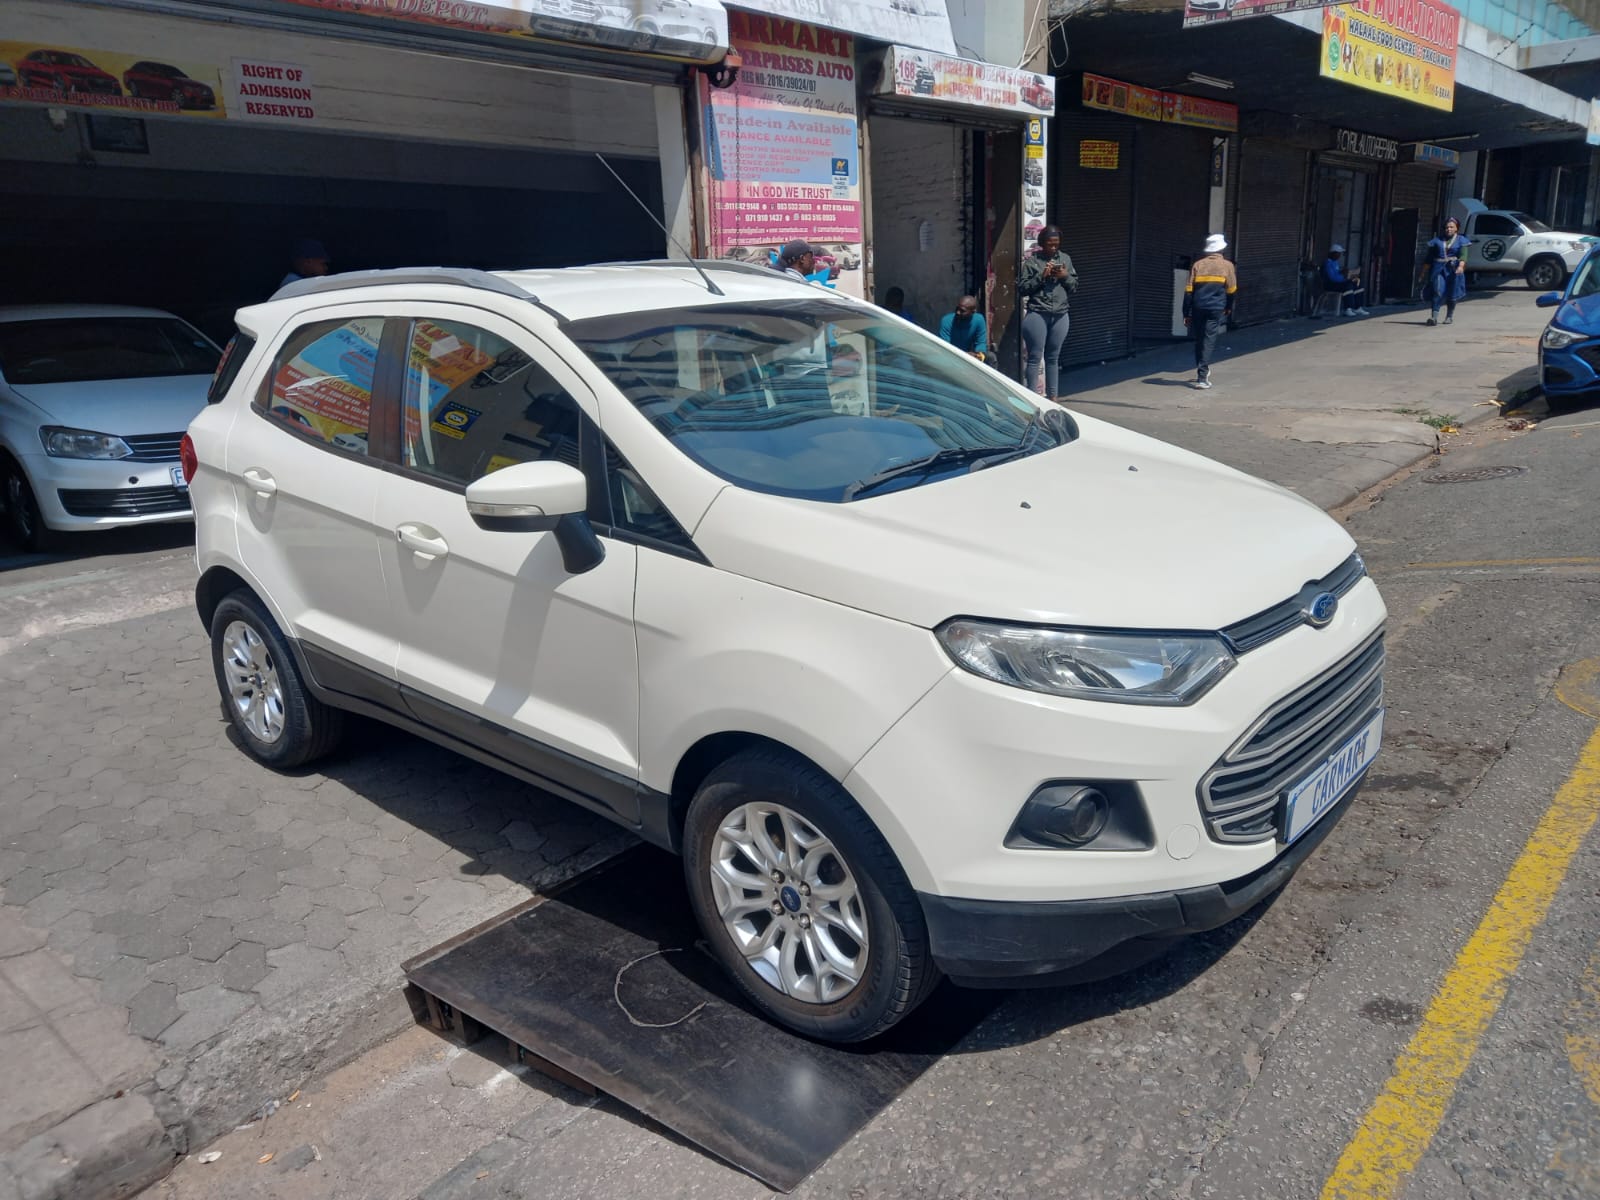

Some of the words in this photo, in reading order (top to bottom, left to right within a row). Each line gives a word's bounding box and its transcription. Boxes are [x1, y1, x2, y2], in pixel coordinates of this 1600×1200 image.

[730, 10, 853, 58] ARMART
[1349, 17, 1377, 44] HALAAL
[1377, 30, 1393, 51] FOOD
[242, 64, 283, 80] RIGHT
[287, 69, 303, 82] OF
[741, 50, 814, 76] ERPRISES
[816, 61, 854, 81] AUTO
[899, 60, 916, 80] 168
[240, 83, 312, 101] ADMISSION
[247, 103, 314, 119] RESERVED
[716, 113, 783, 129] Trade-in
[787, 120, 853, 136] Available
[720, 130, 770, 142] FINANCE
[774, 134, 832, 147] AVAILABLE
[763, 186, 782, 198] GOD
[785, 187, 799, 198] WE
[1312, 730, 1370, 815] CARMART
